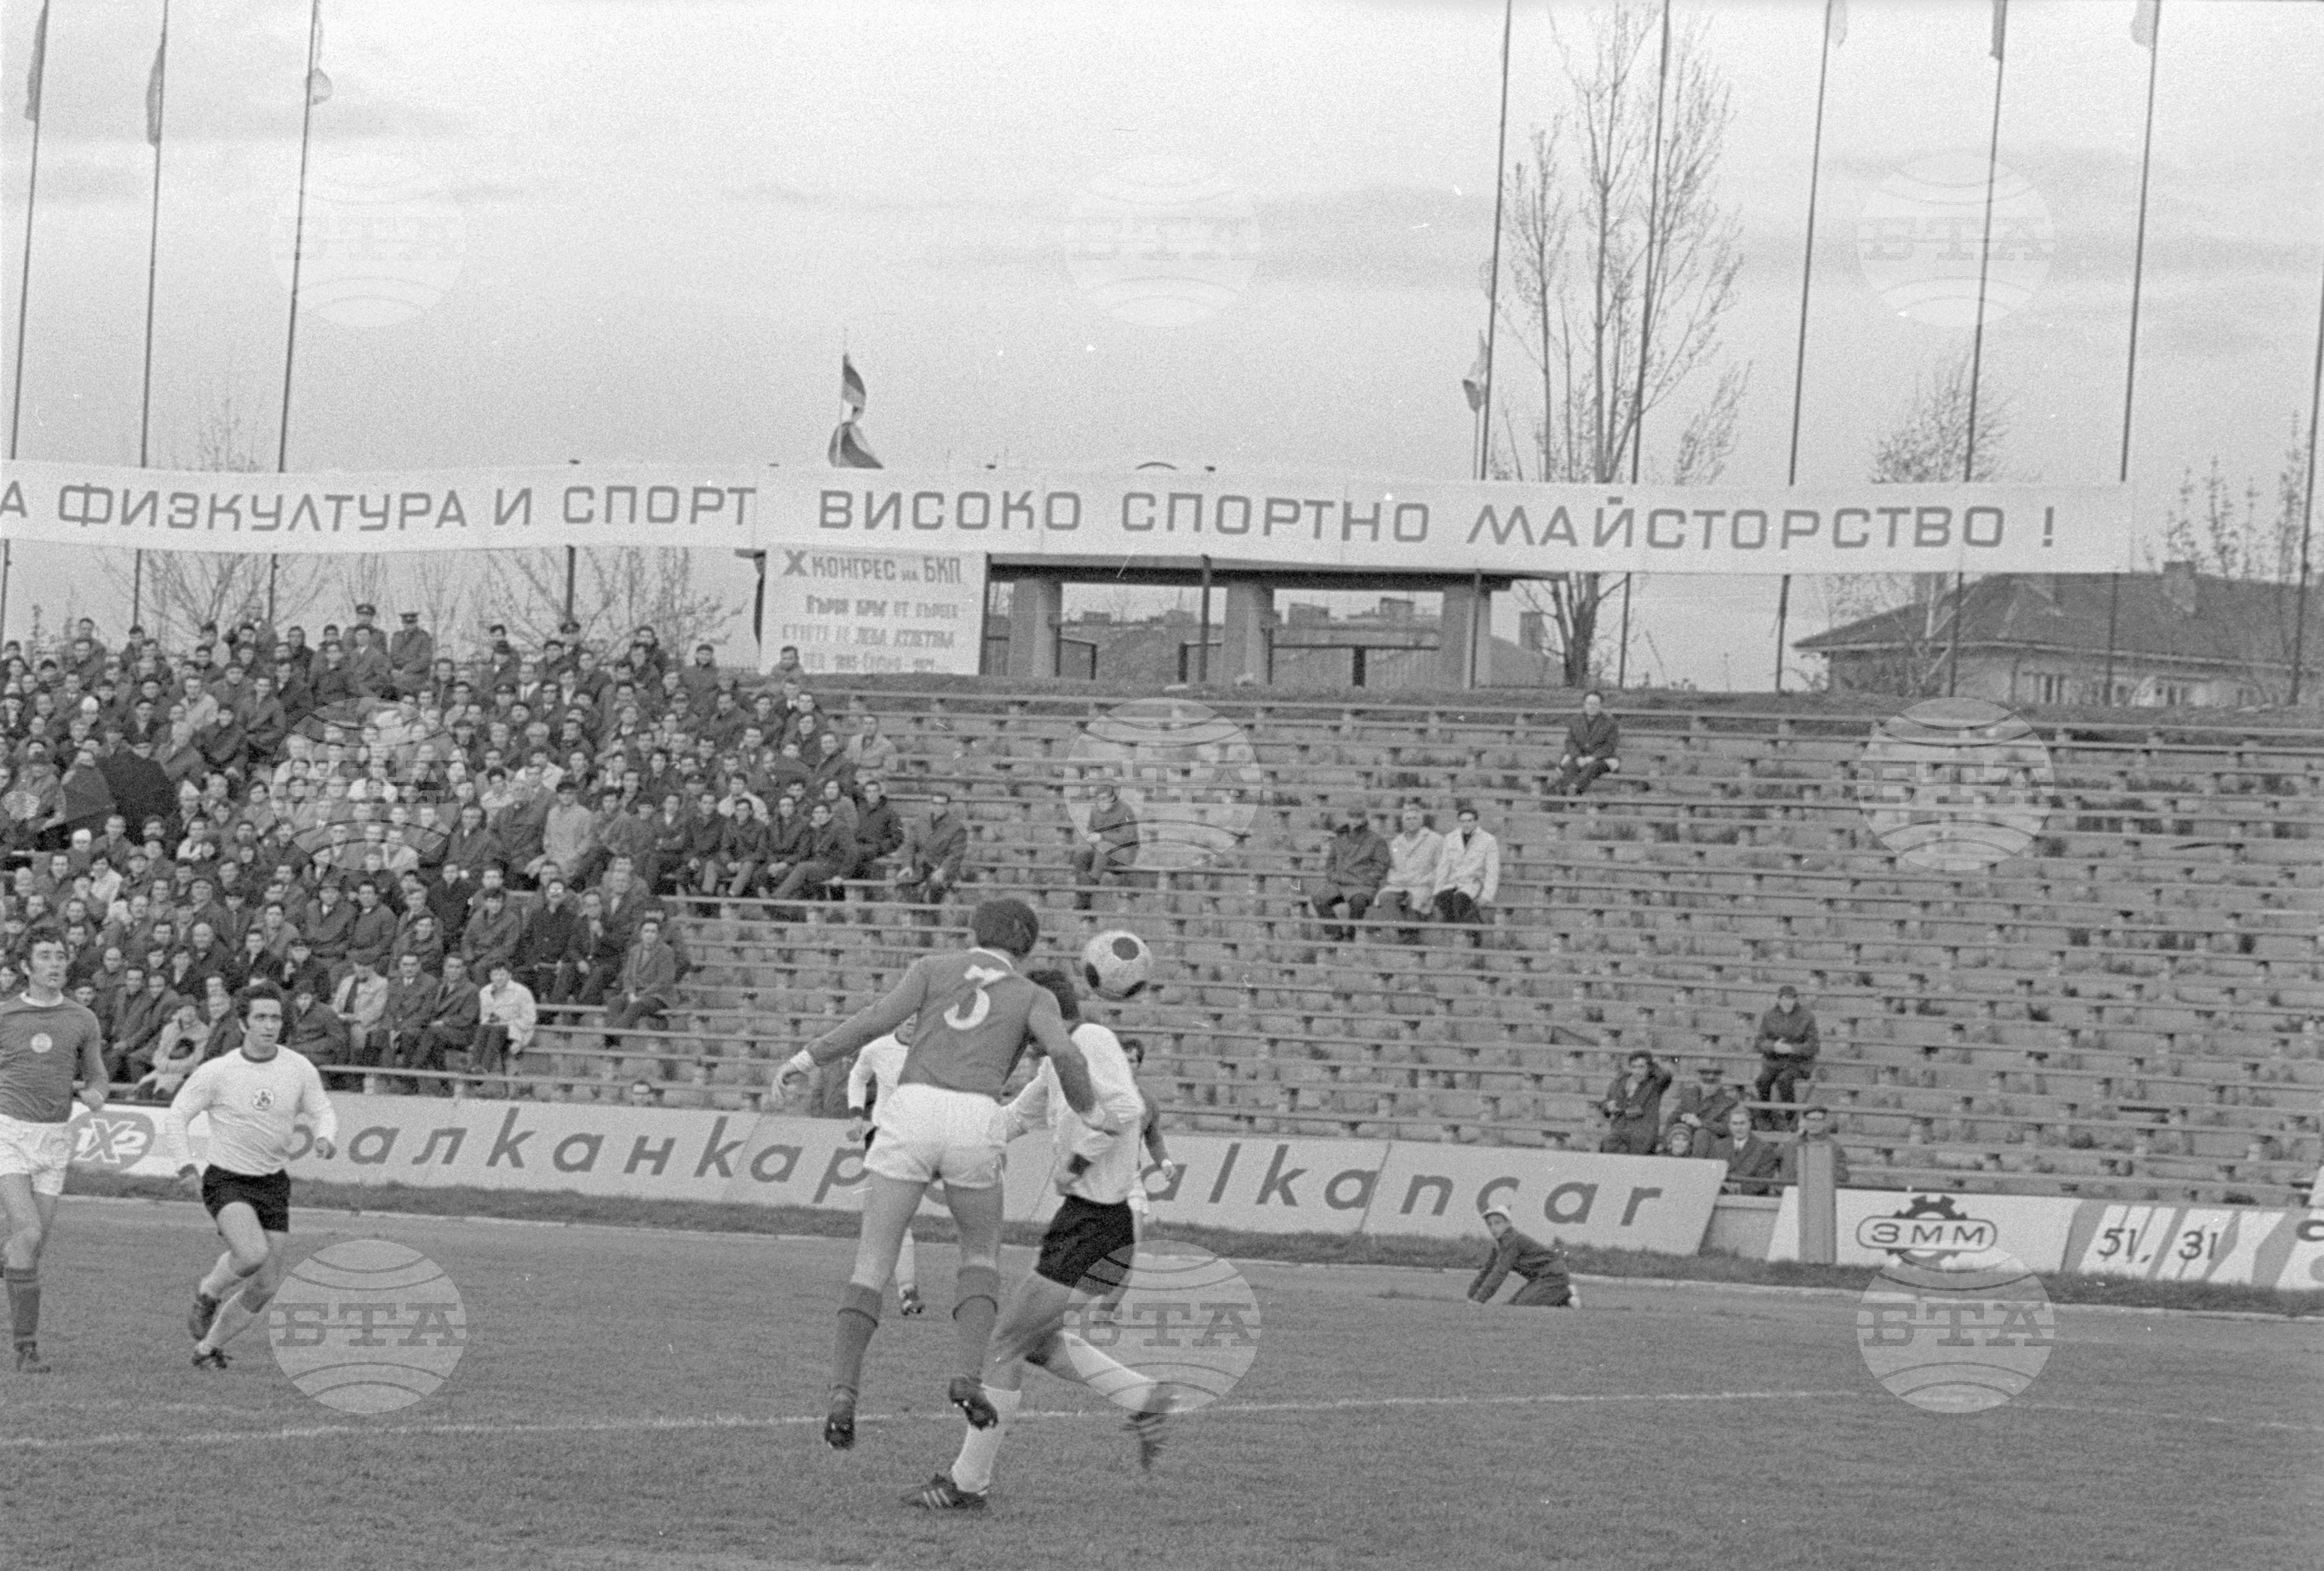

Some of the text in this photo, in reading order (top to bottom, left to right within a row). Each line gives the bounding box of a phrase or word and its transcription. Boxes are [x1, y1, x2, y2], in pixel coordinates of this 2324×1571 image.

[58, 482, 467, 532] ФИЗКУЛТУРА
[494, 486, 533, 526] И
[562, 486, 758, 526] СПОРТ
[819, 490, 1082, 530] ВИСОКО
[1121, 492, 1429, 543] СПОРТНО
[1466, 496, 2005, 550] МАЙСТОРСТВО
[812, 556, 896, 582] КОНГРЕС
[923, 555, 962, 583] БКП
[289, 1107, 870, 1204] алканкар
[1140, 1142, 1663, 1227] alkancar
